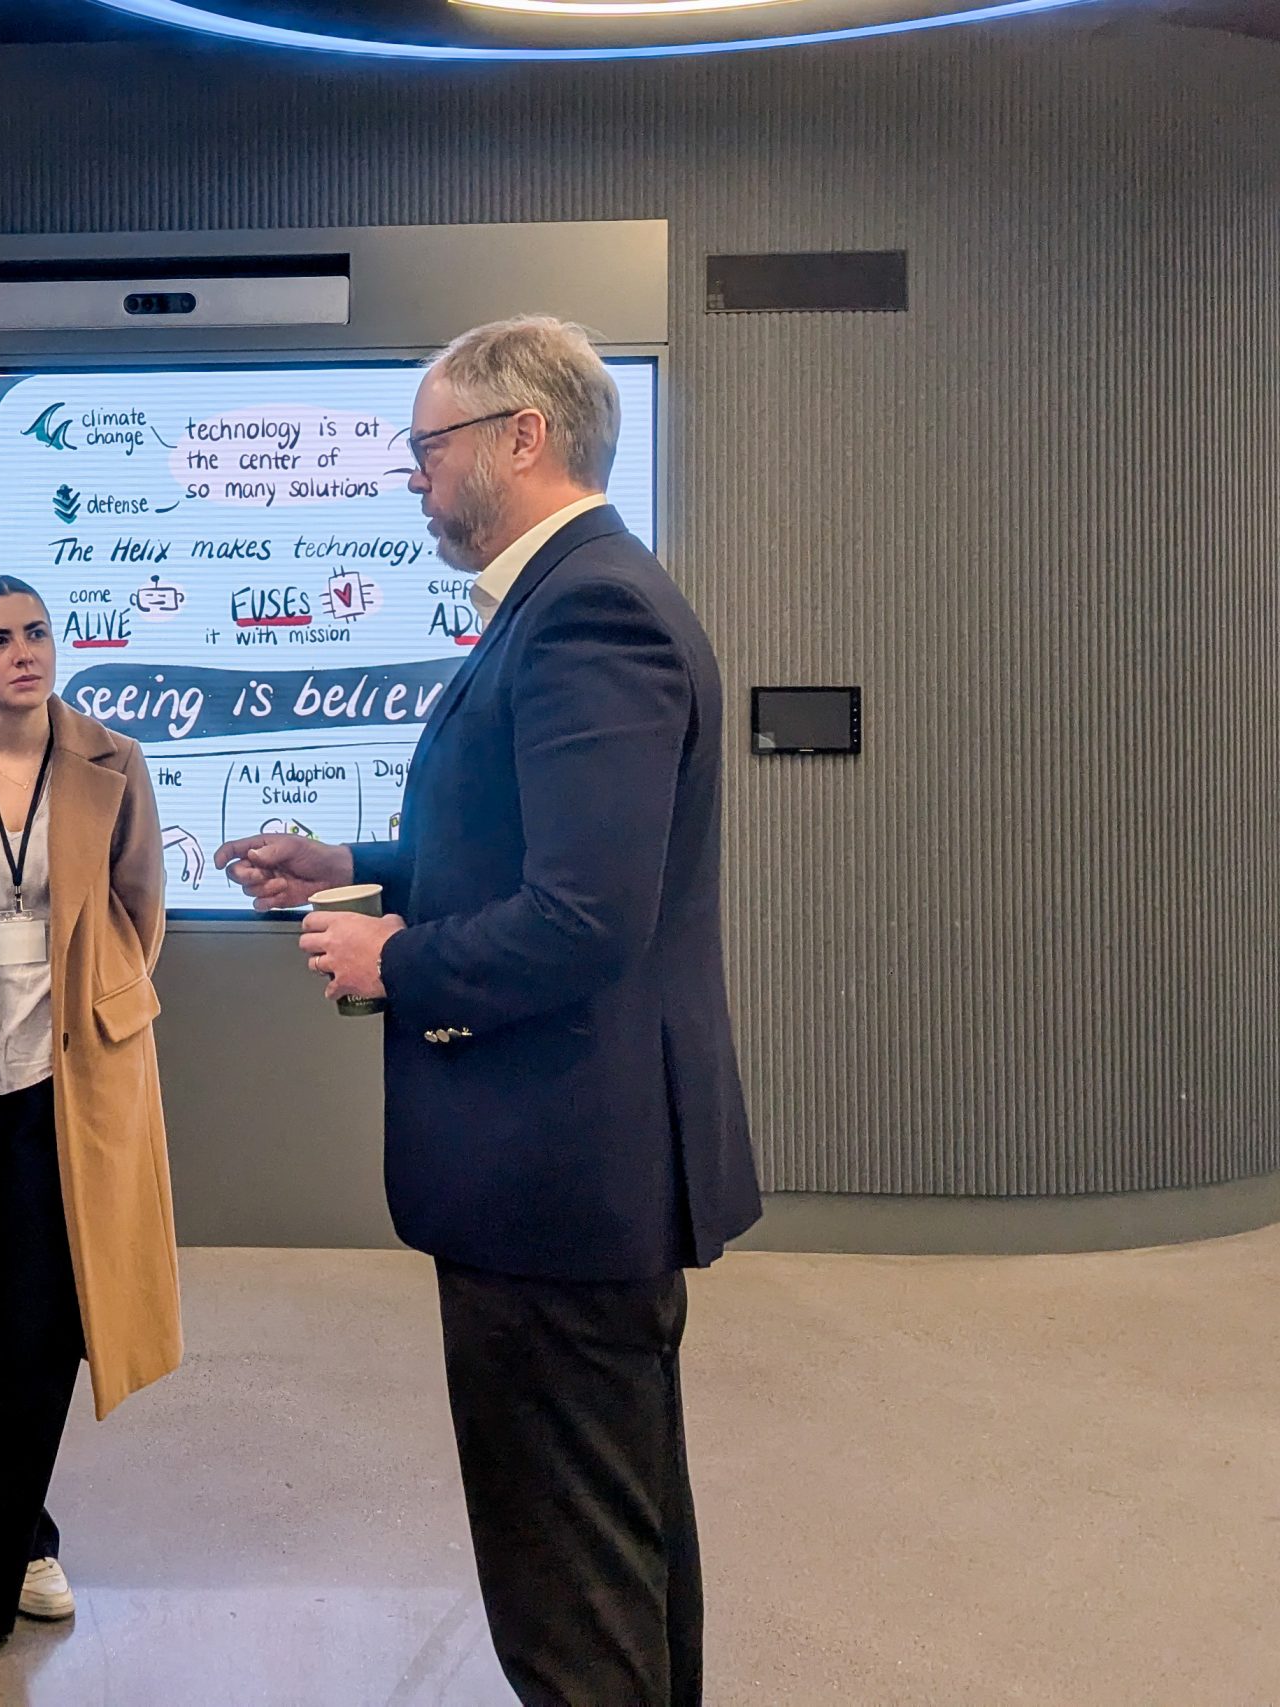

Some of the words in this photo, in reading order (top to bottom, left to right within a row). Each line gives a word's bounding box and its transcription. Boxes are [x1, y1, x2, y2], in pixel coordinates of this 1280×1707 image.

[81, 407, 147, 428] climate
[86, 426, 145, 456] change
[184, 416, 301, 450] technology
[319, 415, 337, 437] is
[354, 416, 380, 438] at
[186, 449, 219, 470] the
[239, 451, 302, 471] center
[317, 446, 341, 468] of
[86, 493, 150, 515] defense
[185, 483, 210, 499] so
[225, 481, 276, 508] many
[288, 478, 379, 499] solutions
[48, 537, 94, 565] The
[110, 537, 171, 564] Helix
[191, 538, 272, 561] makes
[69, 588, 112, 604] come
[231, 586, 311, 621] FUSES
[62, 607, 132, 642] ALIVE
[205, 628, 221, 645] it
[235, 626, 278, 646] with
[289, 627, 351, 643] mission
[74, 675, 204, 739] seeing
[232, 680, 274, 717] is
[158, 767, 182, 787] the
[239, 764, 260, 784] AI
[271, 760, 346, 786] Adoption
[262, 786, 318, 804] Studio
